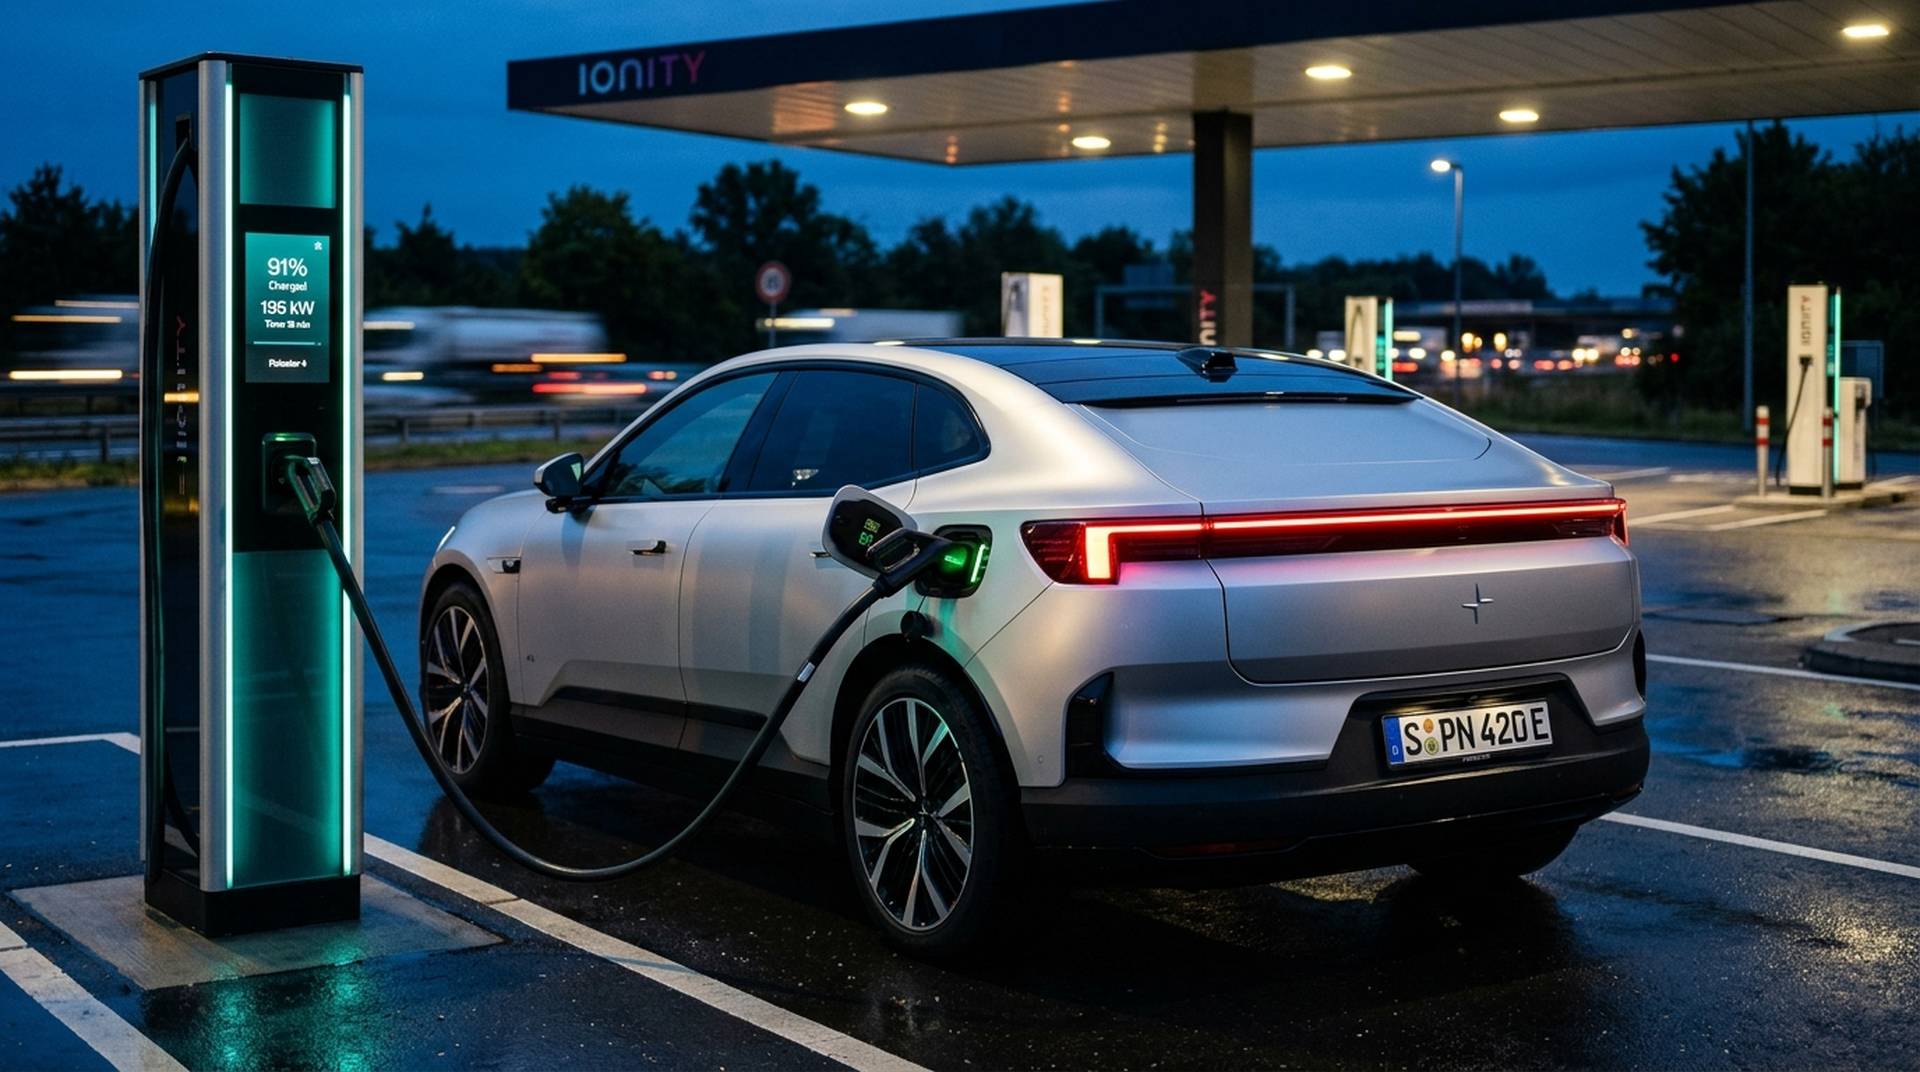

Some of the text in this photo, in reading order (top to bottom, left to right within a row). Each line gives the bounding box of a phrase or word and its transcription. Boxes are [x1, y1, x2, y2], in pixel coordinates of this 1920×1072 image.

[578, 50, 705, 96] IONITY
[267, 257, 308, 277] 91%
[290, 300, 315, 315] kW
[1199, 289, 1217, 345] NITY
[1404, 707, 1550, 756] S PN 420 E
